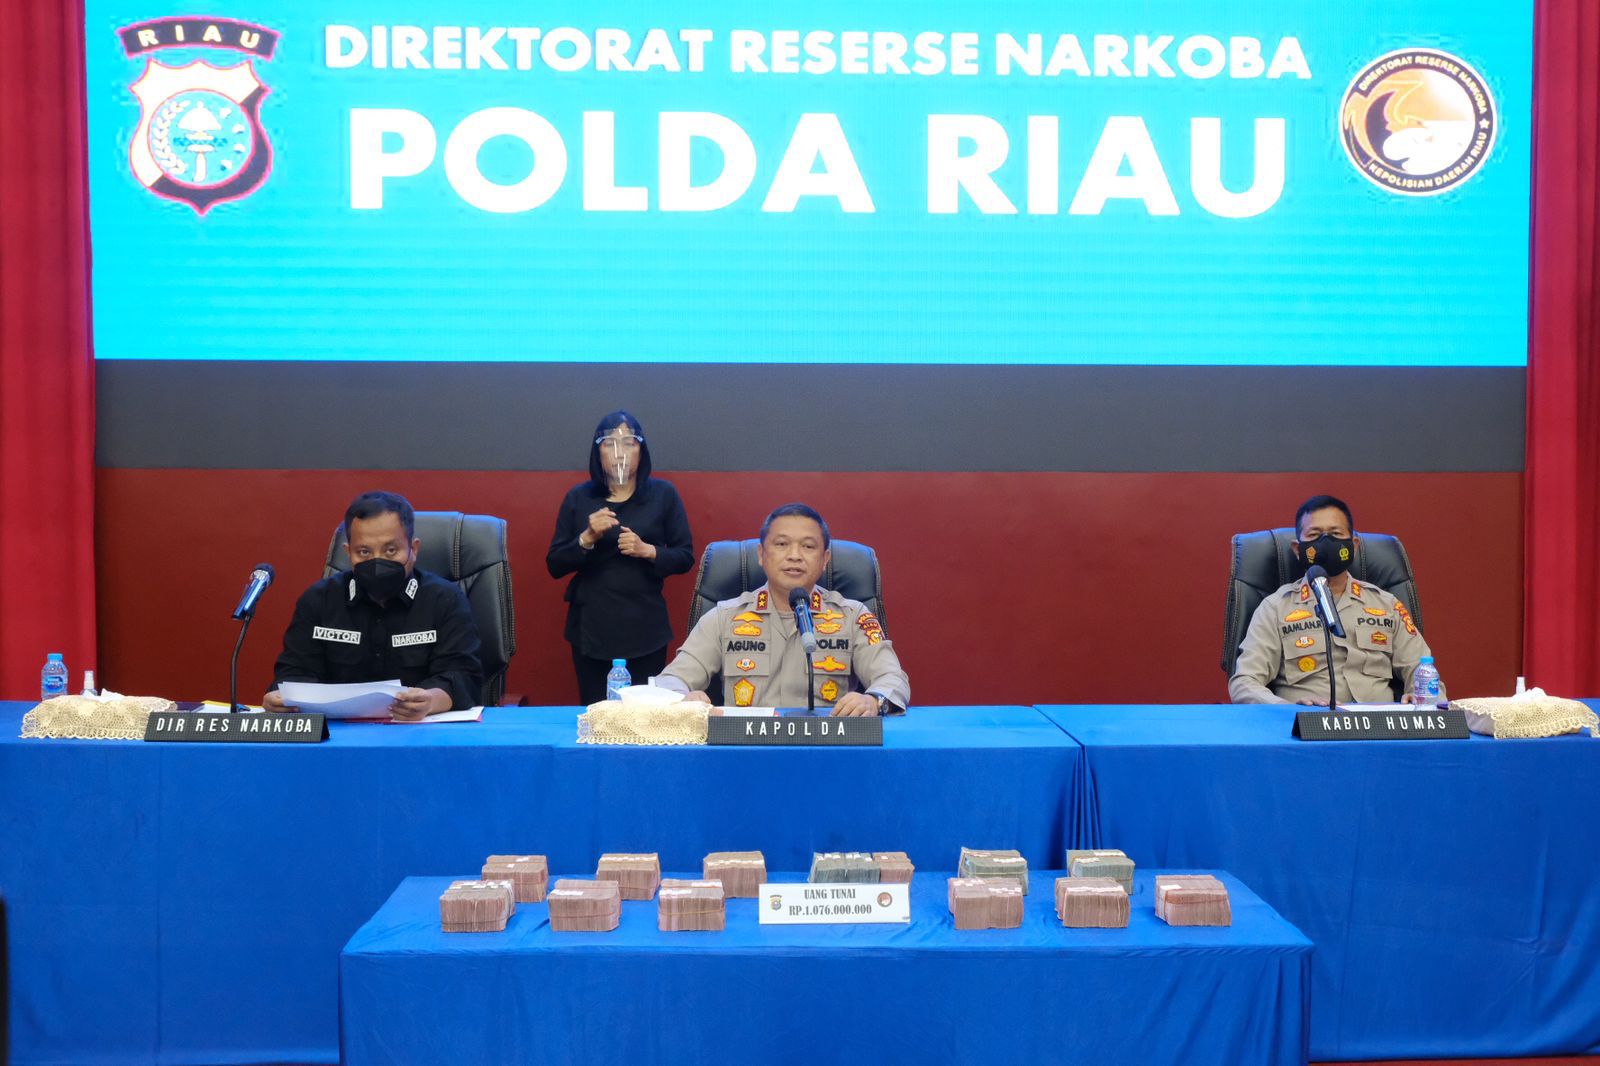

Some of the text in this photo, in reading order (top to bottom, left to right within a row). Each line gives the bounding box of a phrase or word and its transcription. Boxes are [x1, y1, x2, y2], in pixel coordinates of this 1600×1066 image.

[137, 24, 260, 48] RIAU
[325, 25, 1312, 79] DIREKTORAT RESERSE NARKOBA
[1358, 56, 1488, 114] DIREKTORAT RESERSE NARKOBA
[350, 107, 1286, 218] POLDA RIAU
[1368, 132, 1487, 188] KEPOLISIAN DAERAH RIAU
[1357, 617, 1393, 629] POLRI
[316, 628, 358, 642] VICTOR
[394, 632, 434, 646] NARKOBA
[726, 639, 766, 652] AGUNG
[816, 638, 849, 650] OLRI
[156, 717, 312, 733] DIR RES NARKOBA
[745, 721, 845, 736] KAPOLDA
[1322, 715, 1447, 731] KABID HUMAS
[804, 888, 856, 900] UANG TUNAI
[789, 904, 872, 916] RP.1.076.000.000
